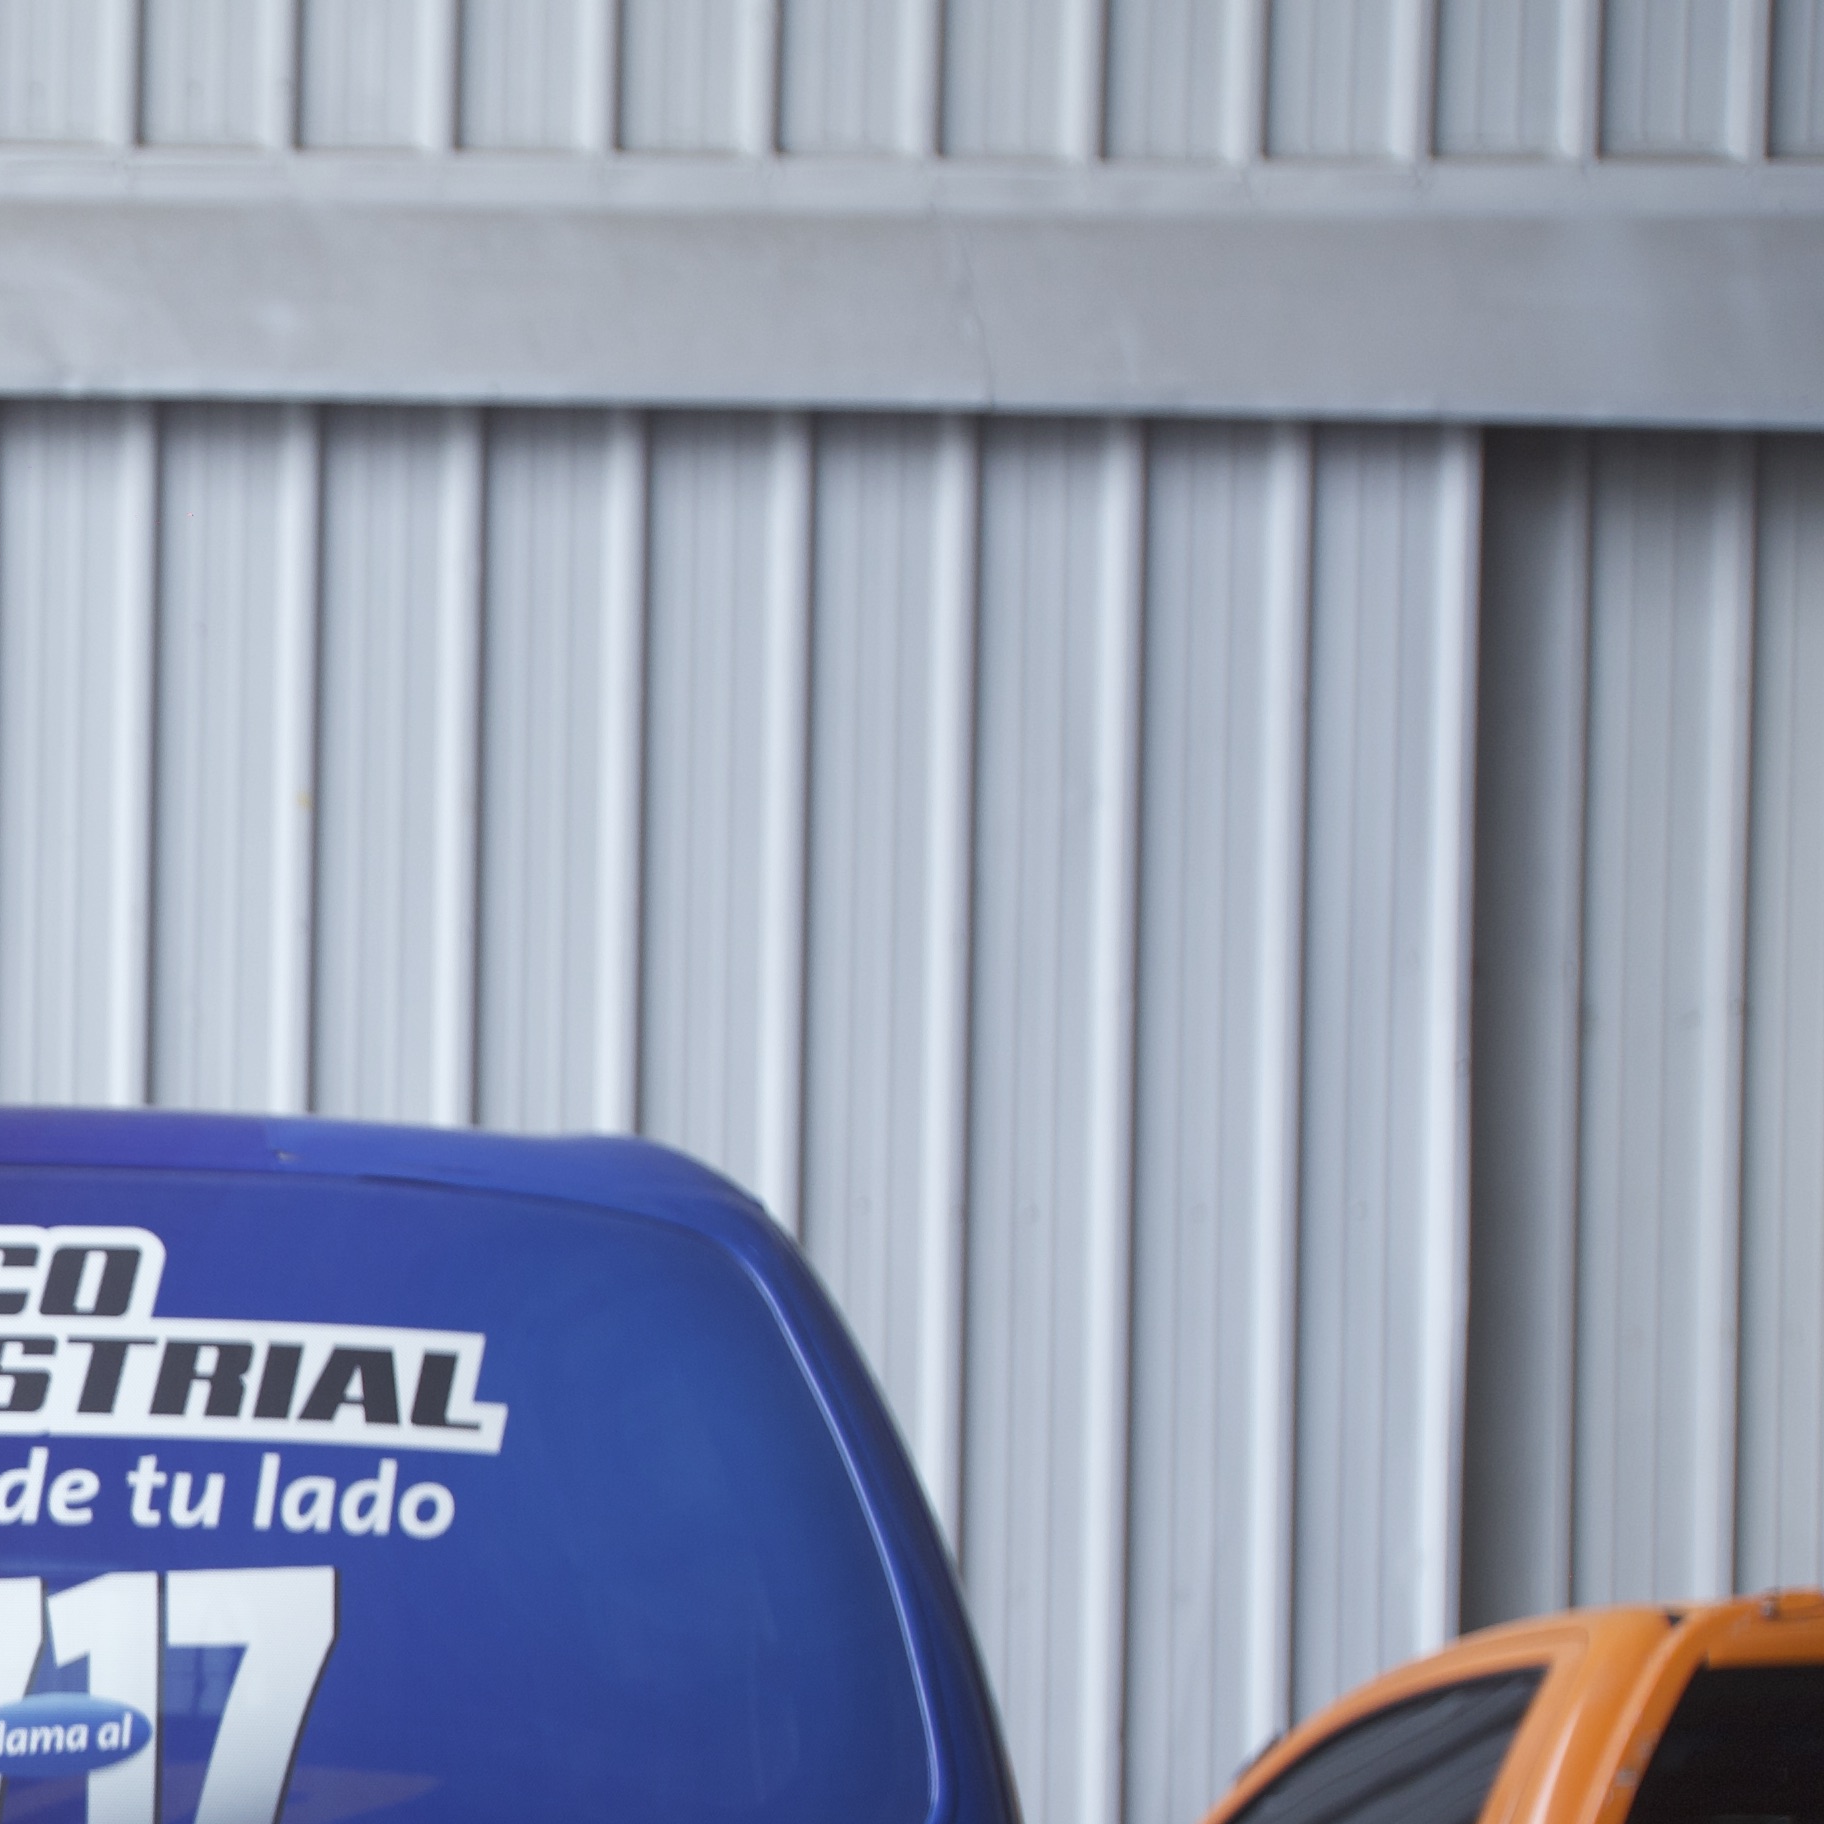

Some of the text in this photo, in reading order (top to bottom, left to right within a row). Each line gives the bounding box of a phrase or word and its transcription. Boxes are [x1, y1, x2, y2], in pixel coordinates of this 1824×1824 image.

[127, 1453, 225, 1529] tu
[253, 1451, 455, 1540] lado
[97, 1711, 133, 1750] al
